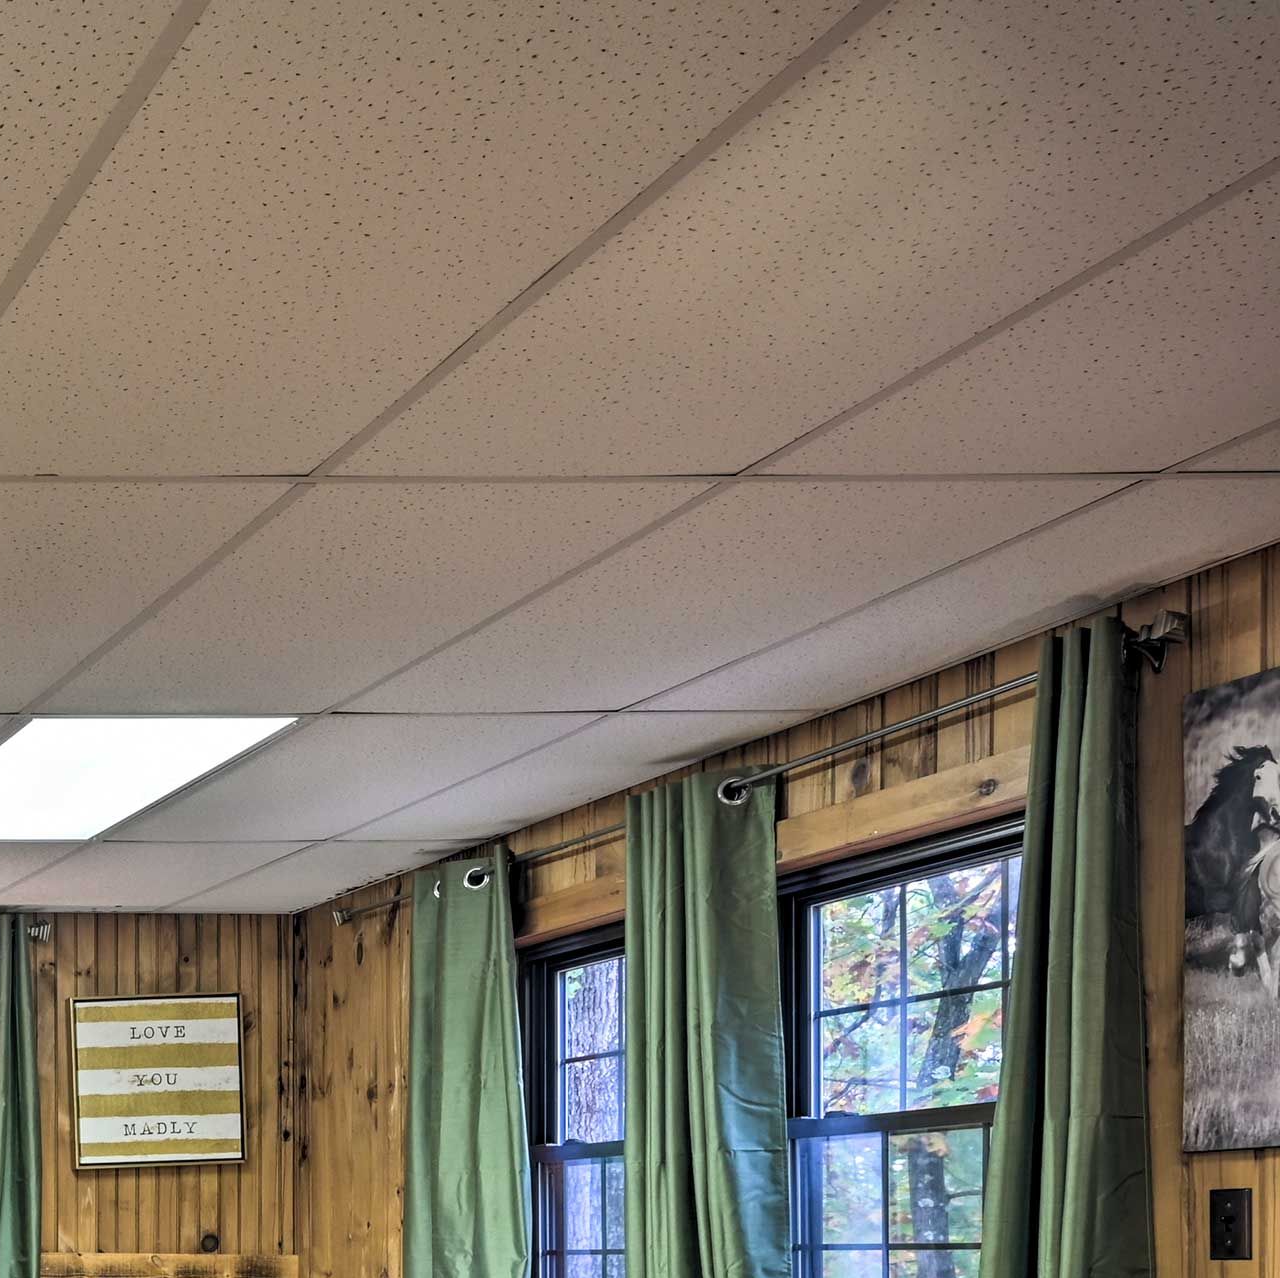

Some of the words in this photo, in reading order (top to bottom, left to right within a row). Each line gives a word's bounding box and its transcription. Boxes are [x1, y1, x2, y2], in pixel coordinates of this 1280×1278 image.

[130, 1025, 186, 1040] LOVE
[134, 1073, 179, 1087] YOU
[123, 1121, 198, 1137] MADLY
